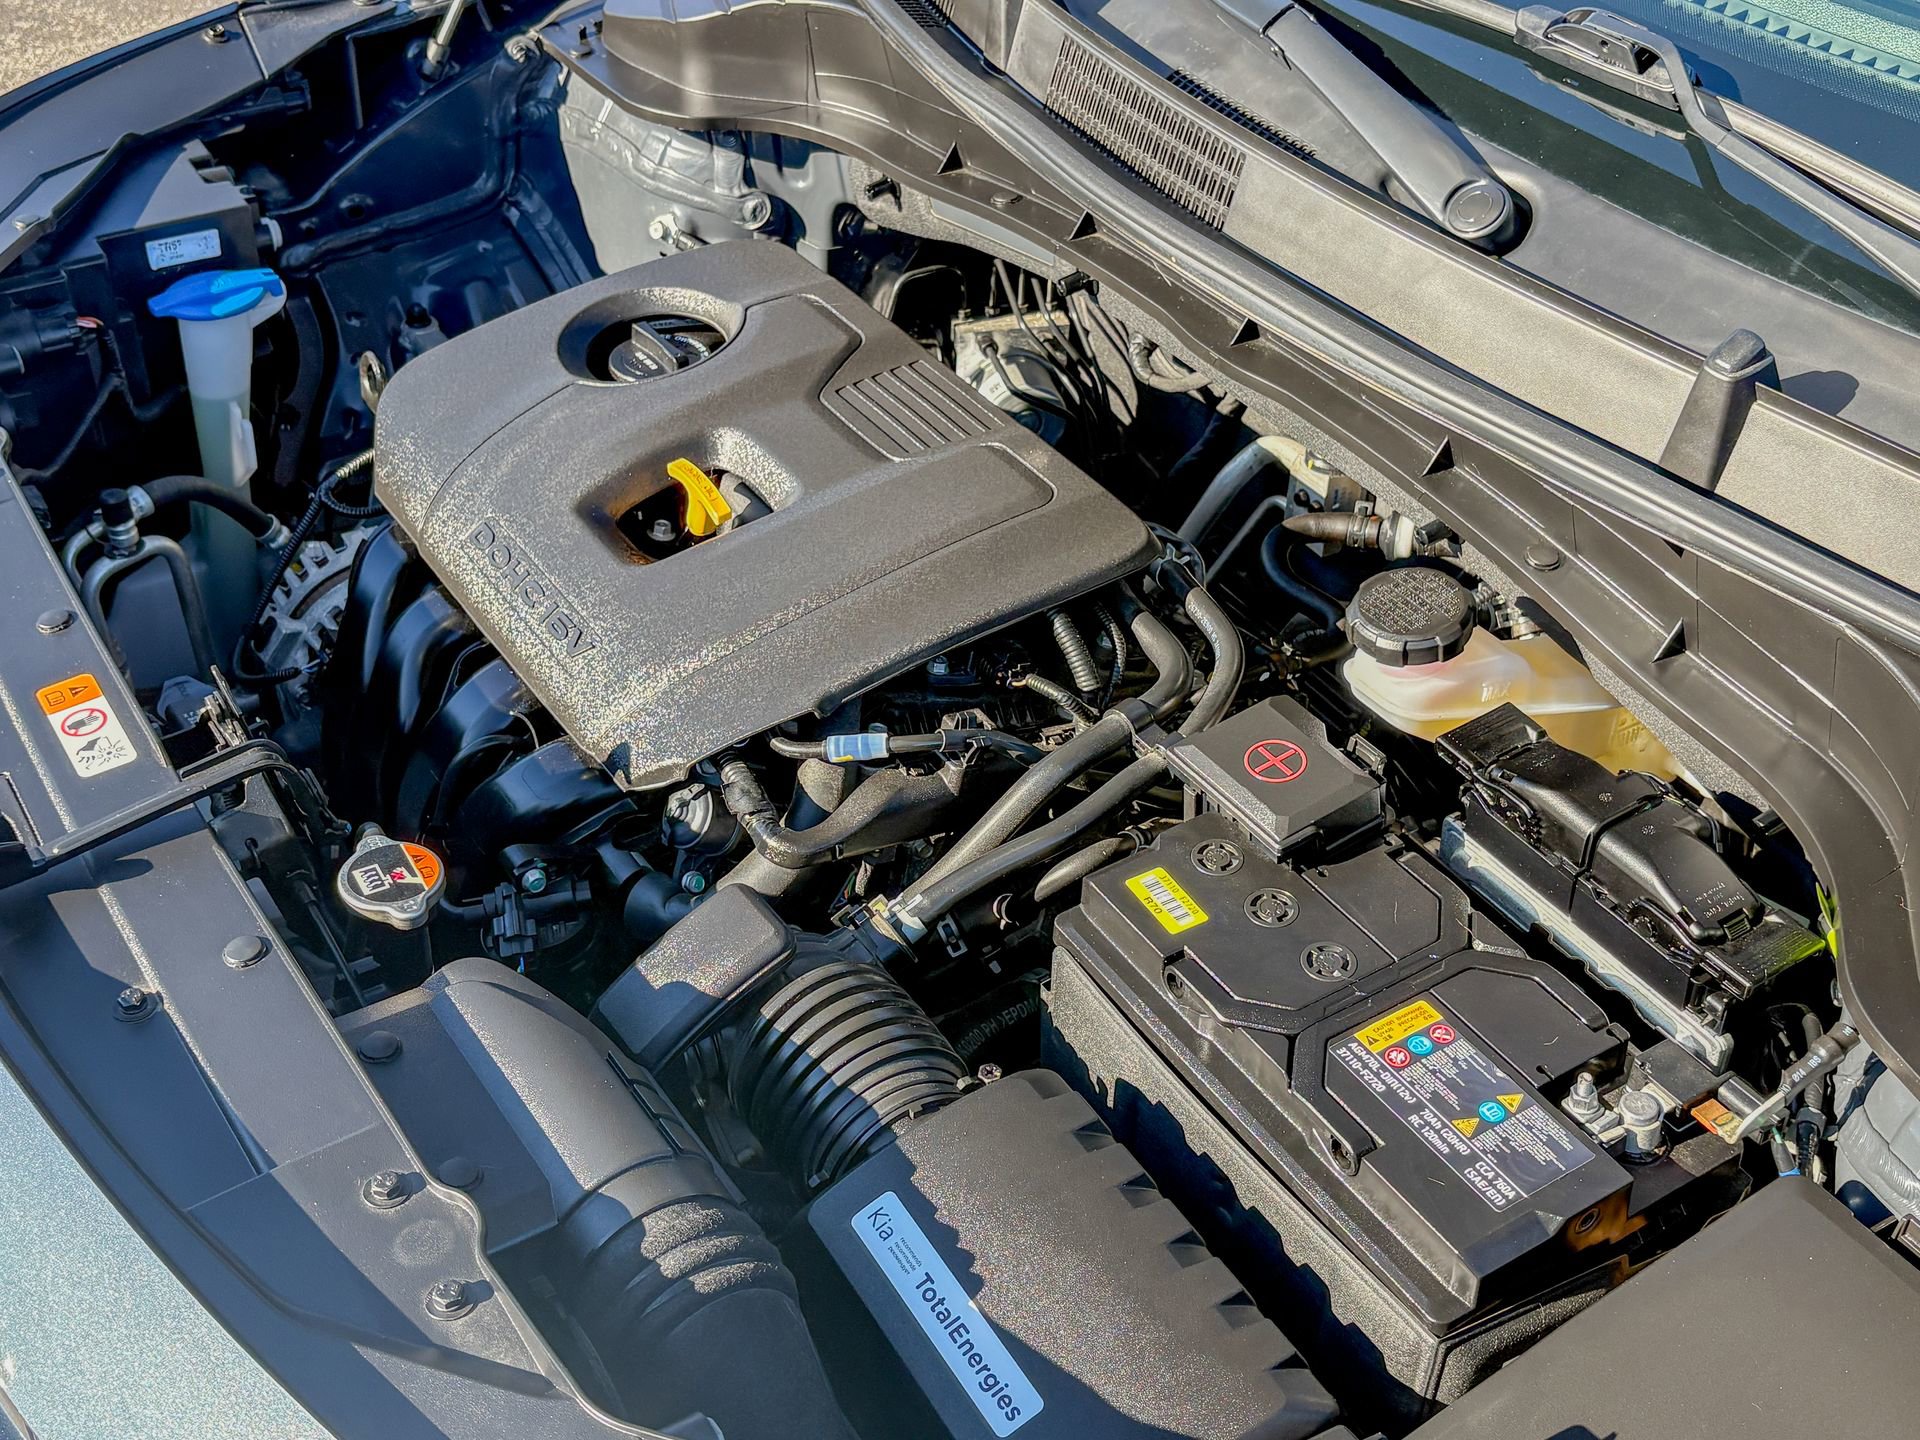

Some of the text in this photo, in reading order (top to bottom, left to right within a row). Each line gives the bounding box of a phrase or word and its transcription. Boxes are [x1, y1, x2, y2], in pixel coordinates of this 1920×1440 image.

[470, 521, 596, 658] DOHC 16V
[1144, 896, 1163, 914] R70
[1336, 1046, 1386, 1092] 37110-F2720
[1408, 1115, 1423, 1131] RC
[1418, 1126, 1450, 1155] 120min
[1419, 1109, 1441, 1130] 70Ah
[1440, 1126, 1471, 1155] (20HR)
[1474, 1161, 1496, 1180] CCA
[1492, 1178, 1516, 1199] 760A
[867, 1206, 894, 1242] Kia
[915, 1271, 1021, 1422] TotalEnergies
